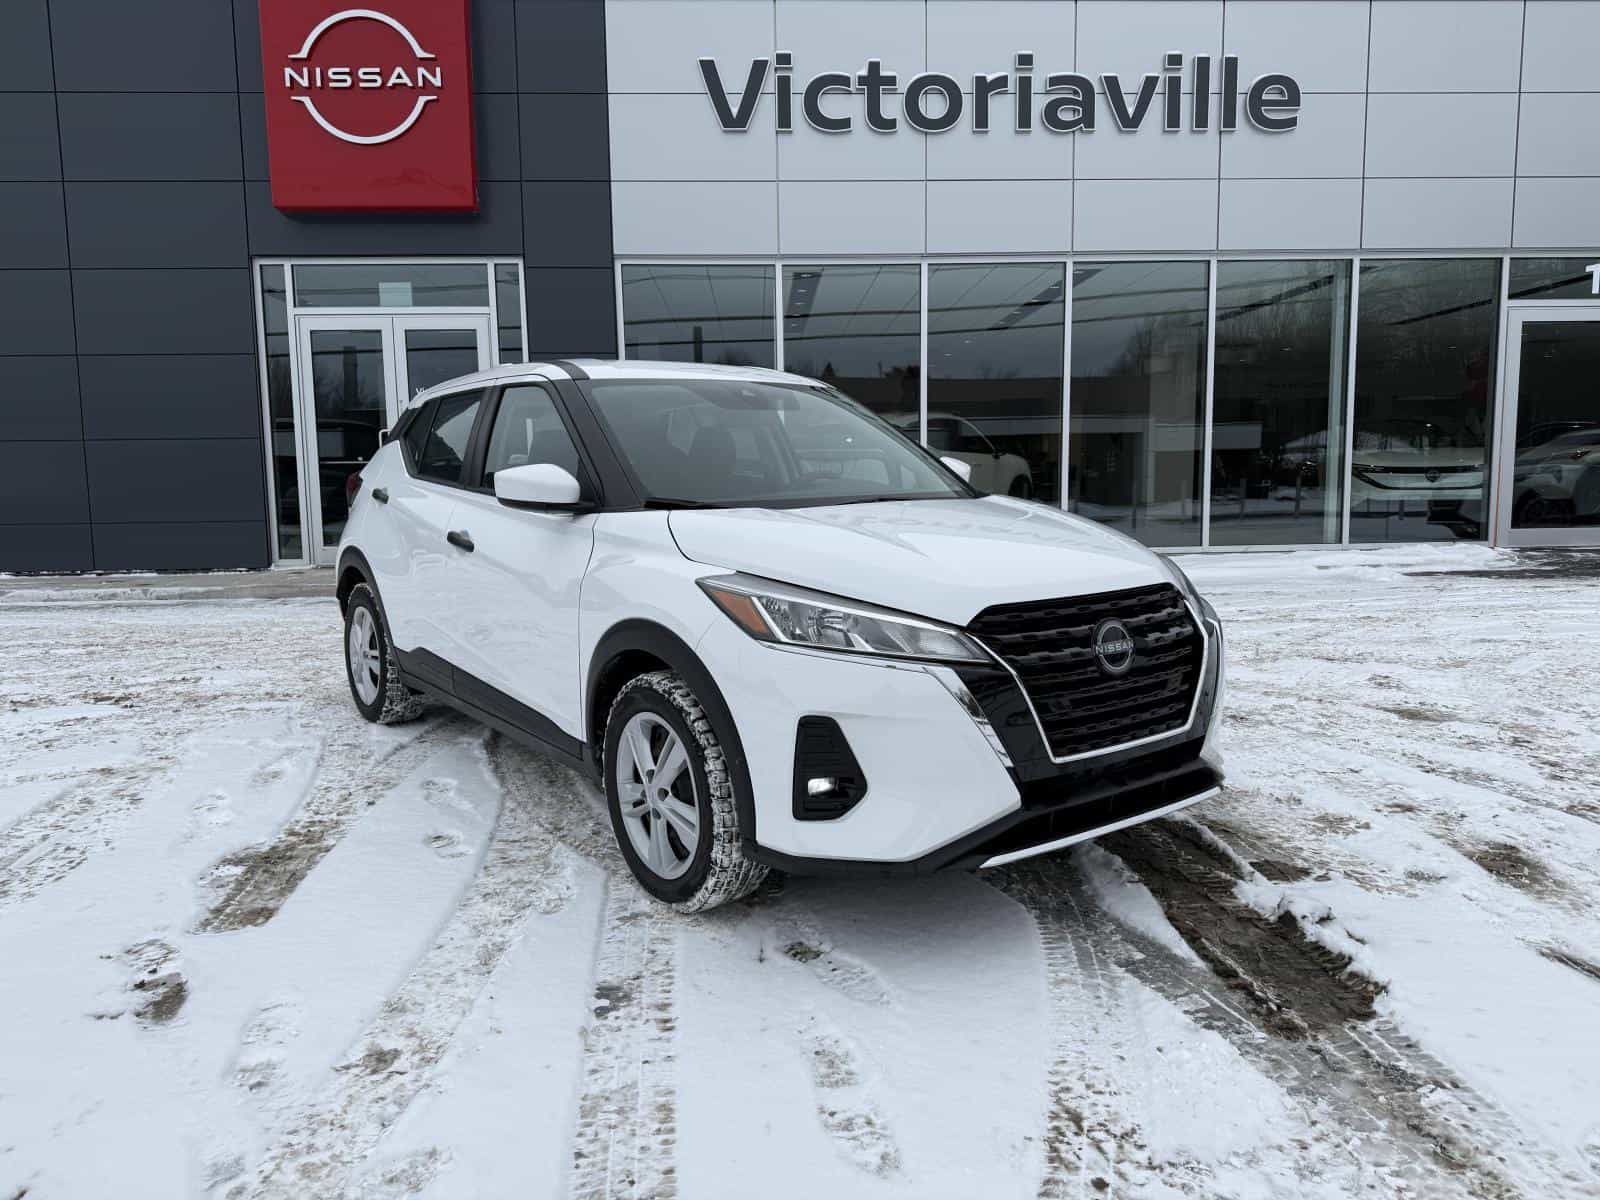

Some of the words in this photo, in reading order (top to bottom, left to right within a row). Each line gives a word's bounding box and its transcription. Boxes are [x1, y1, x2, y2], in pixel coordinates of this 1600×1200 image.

[283, 66, 442, 88] NISSAN
[697, 51, 1302, 134] Victoriaville
[1095, 640, 1134, 656] NISSAN
